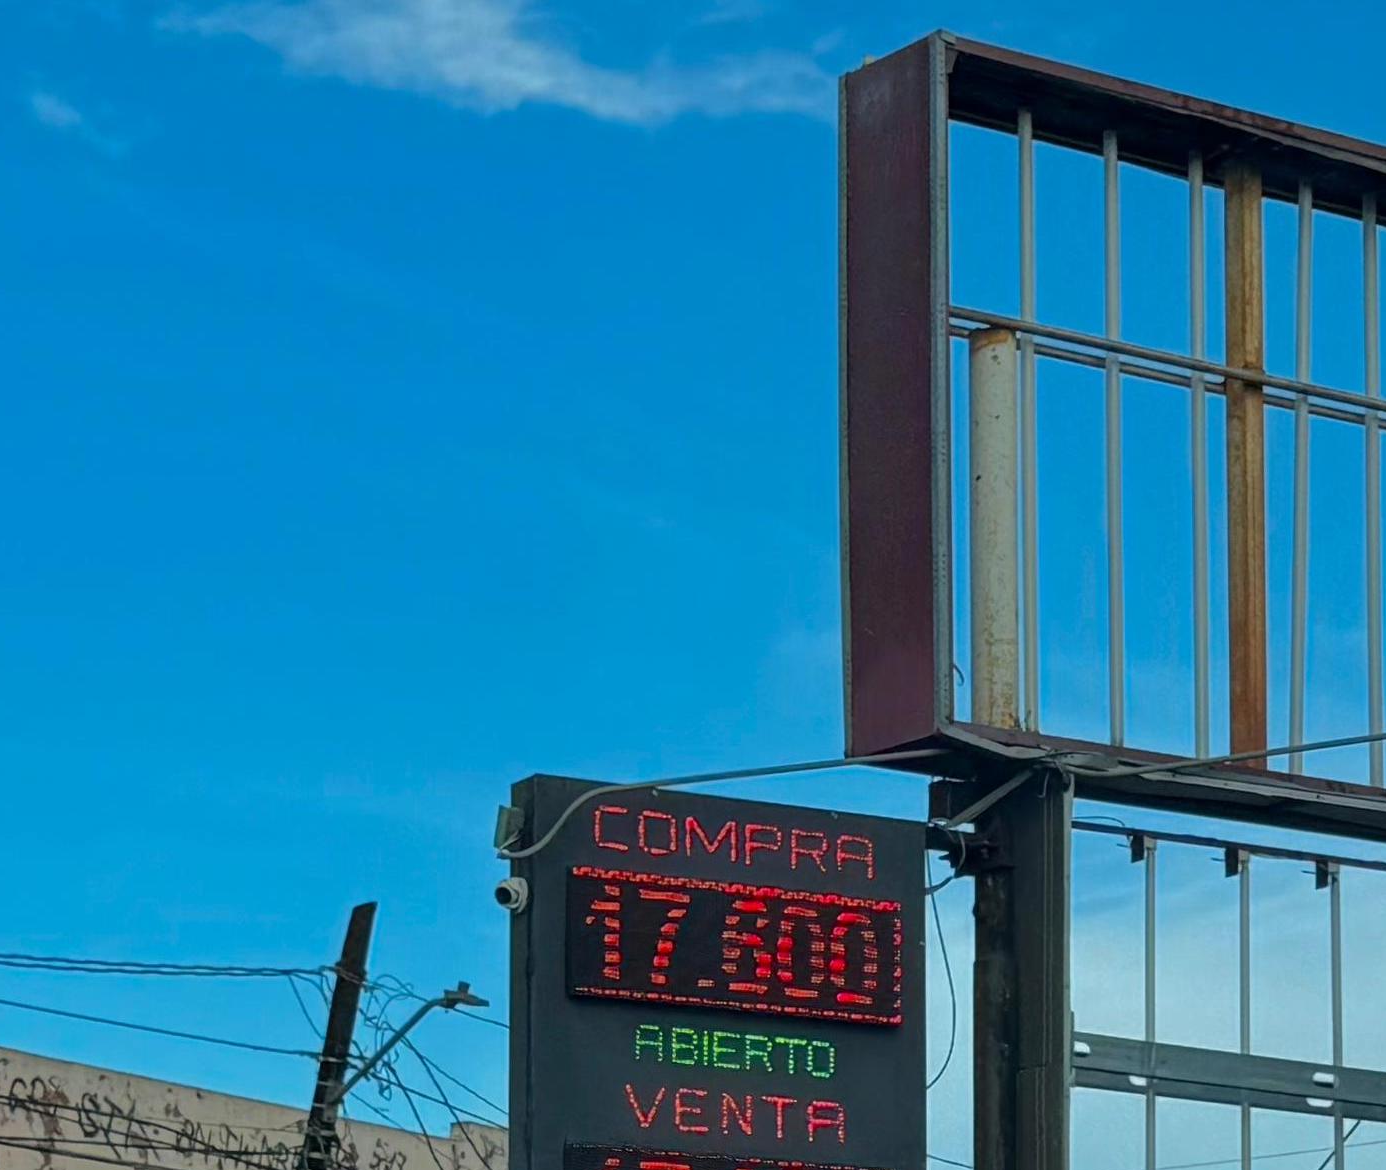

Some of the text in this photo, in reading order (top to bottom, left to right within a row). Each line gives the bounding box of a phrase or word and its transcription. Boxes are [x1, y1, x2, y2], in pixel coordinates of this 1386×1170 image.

[592, 805, 877, 880] COMPRA
[634, 1024, 837, 1079] ABIERTO
[625, 1084, 848, 1145] VENTA
